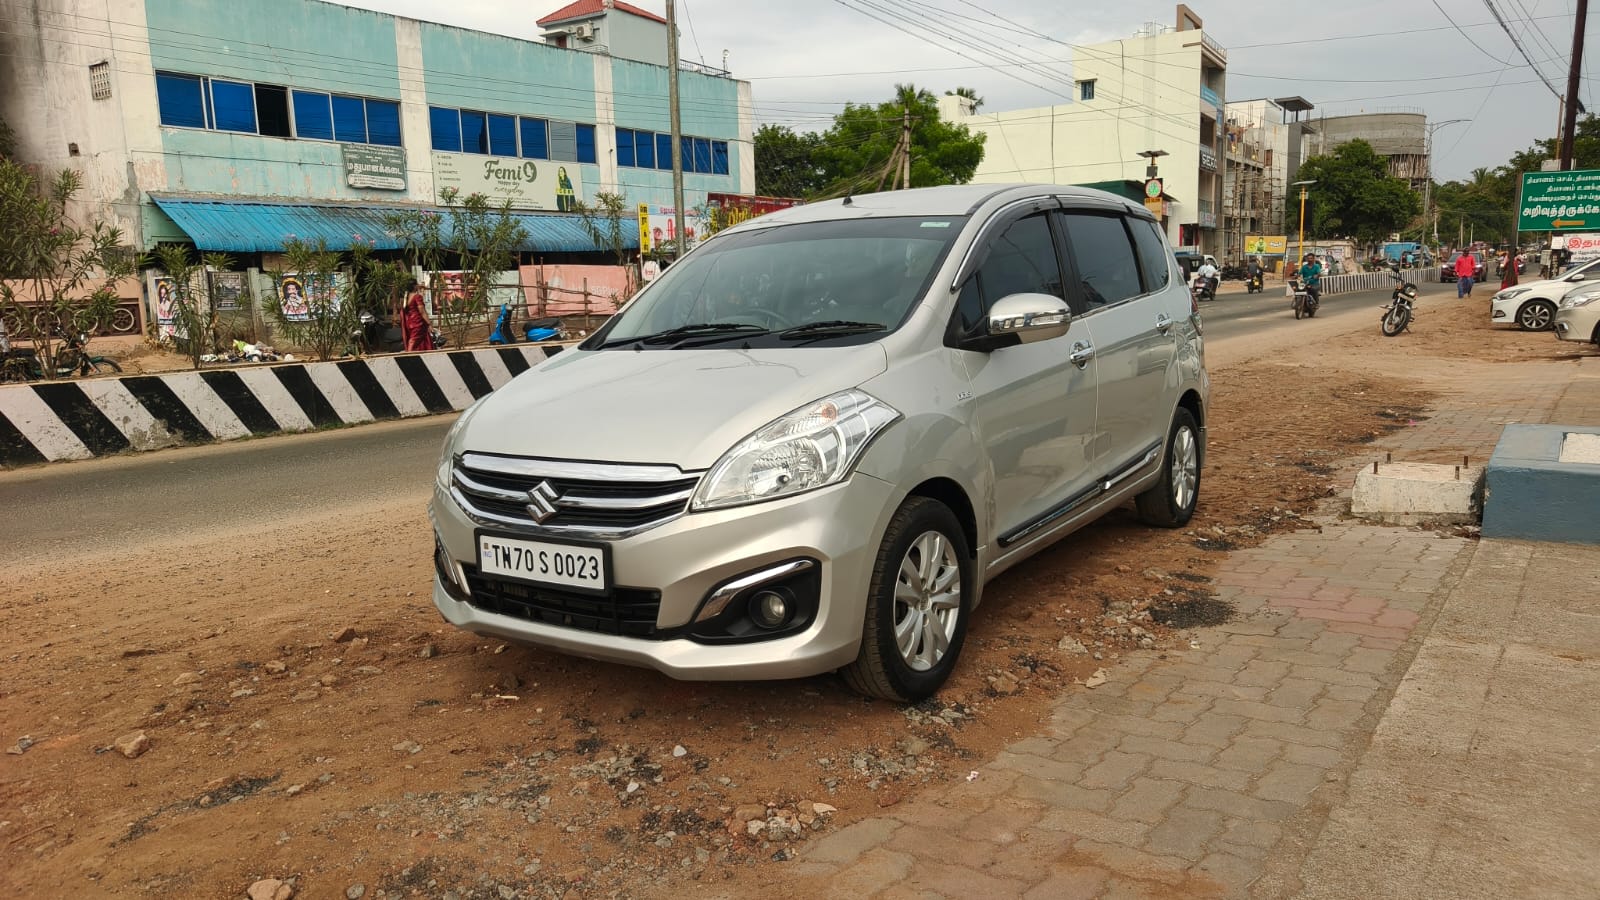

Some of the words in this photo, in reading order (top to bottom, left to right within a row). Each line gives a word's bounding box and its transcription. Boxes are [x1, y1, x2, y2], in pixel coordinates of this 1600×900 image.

[492, 544, 534, 572] TN70
[539, 551, 549, 574] S
[554, 552, 599, 580] 0023
